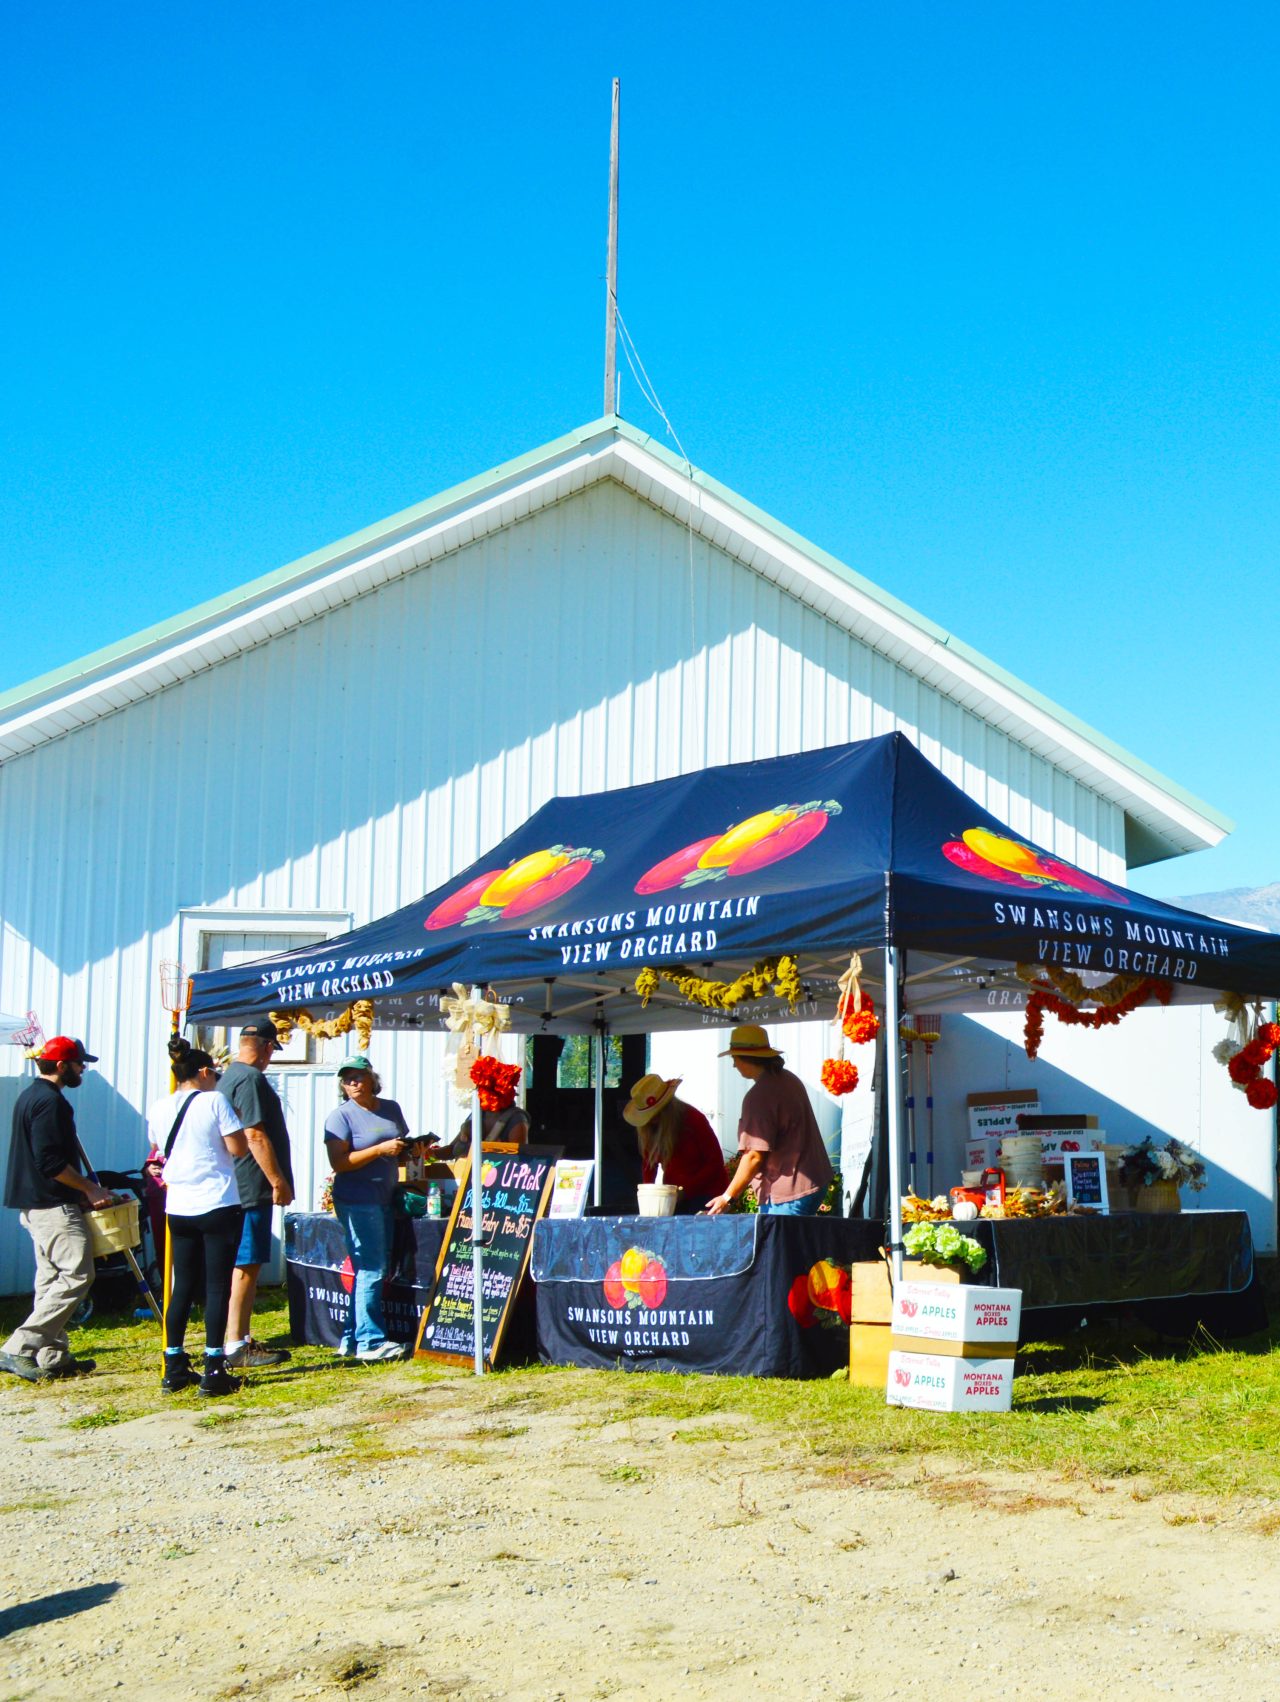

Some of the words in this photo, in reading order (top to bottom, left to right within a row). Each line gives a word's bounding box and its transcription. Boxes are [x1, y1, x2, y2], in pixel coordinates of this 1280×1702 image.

[528, 911, 636, 941] SWANSONS
[646, 896, 761, 928] MOUNTAIN
[994, 902, 1114, 938] SWANSONS
[1125, 920, 1229, 957] MOUNTAIN
[561, 941, 611, 965] VIEW
[620, 930, 717, 959] ORCHARD
[1038, 939, 1092, 965] VIEW
[1104, 948, 1198, 980] ORCHARD
[278, 982, 316, 1003] VIEW
[321, 970, 394, 997] ORCHARD
[977, 1116, 1012, 1127] APPLES
[309, 1287, 351, 1307] SWANSO
[921, 1305, 956, 1319] APPLES
[974, 1303, 1011, 1311] MONTANA
[568, 1307, 632, 1325] SWANSONS
[639, 1310, 713, 1326] MOUNTAIN
[976, 1316, 1008, 1326] APPLES
[589, 1329, 618, 1345] VIEW
[625, 1331, 690, 1346] ORCHARD
[914, 1374, 946, 1388] APPLES
[966, 1386, 1000, 1395] APPLES
